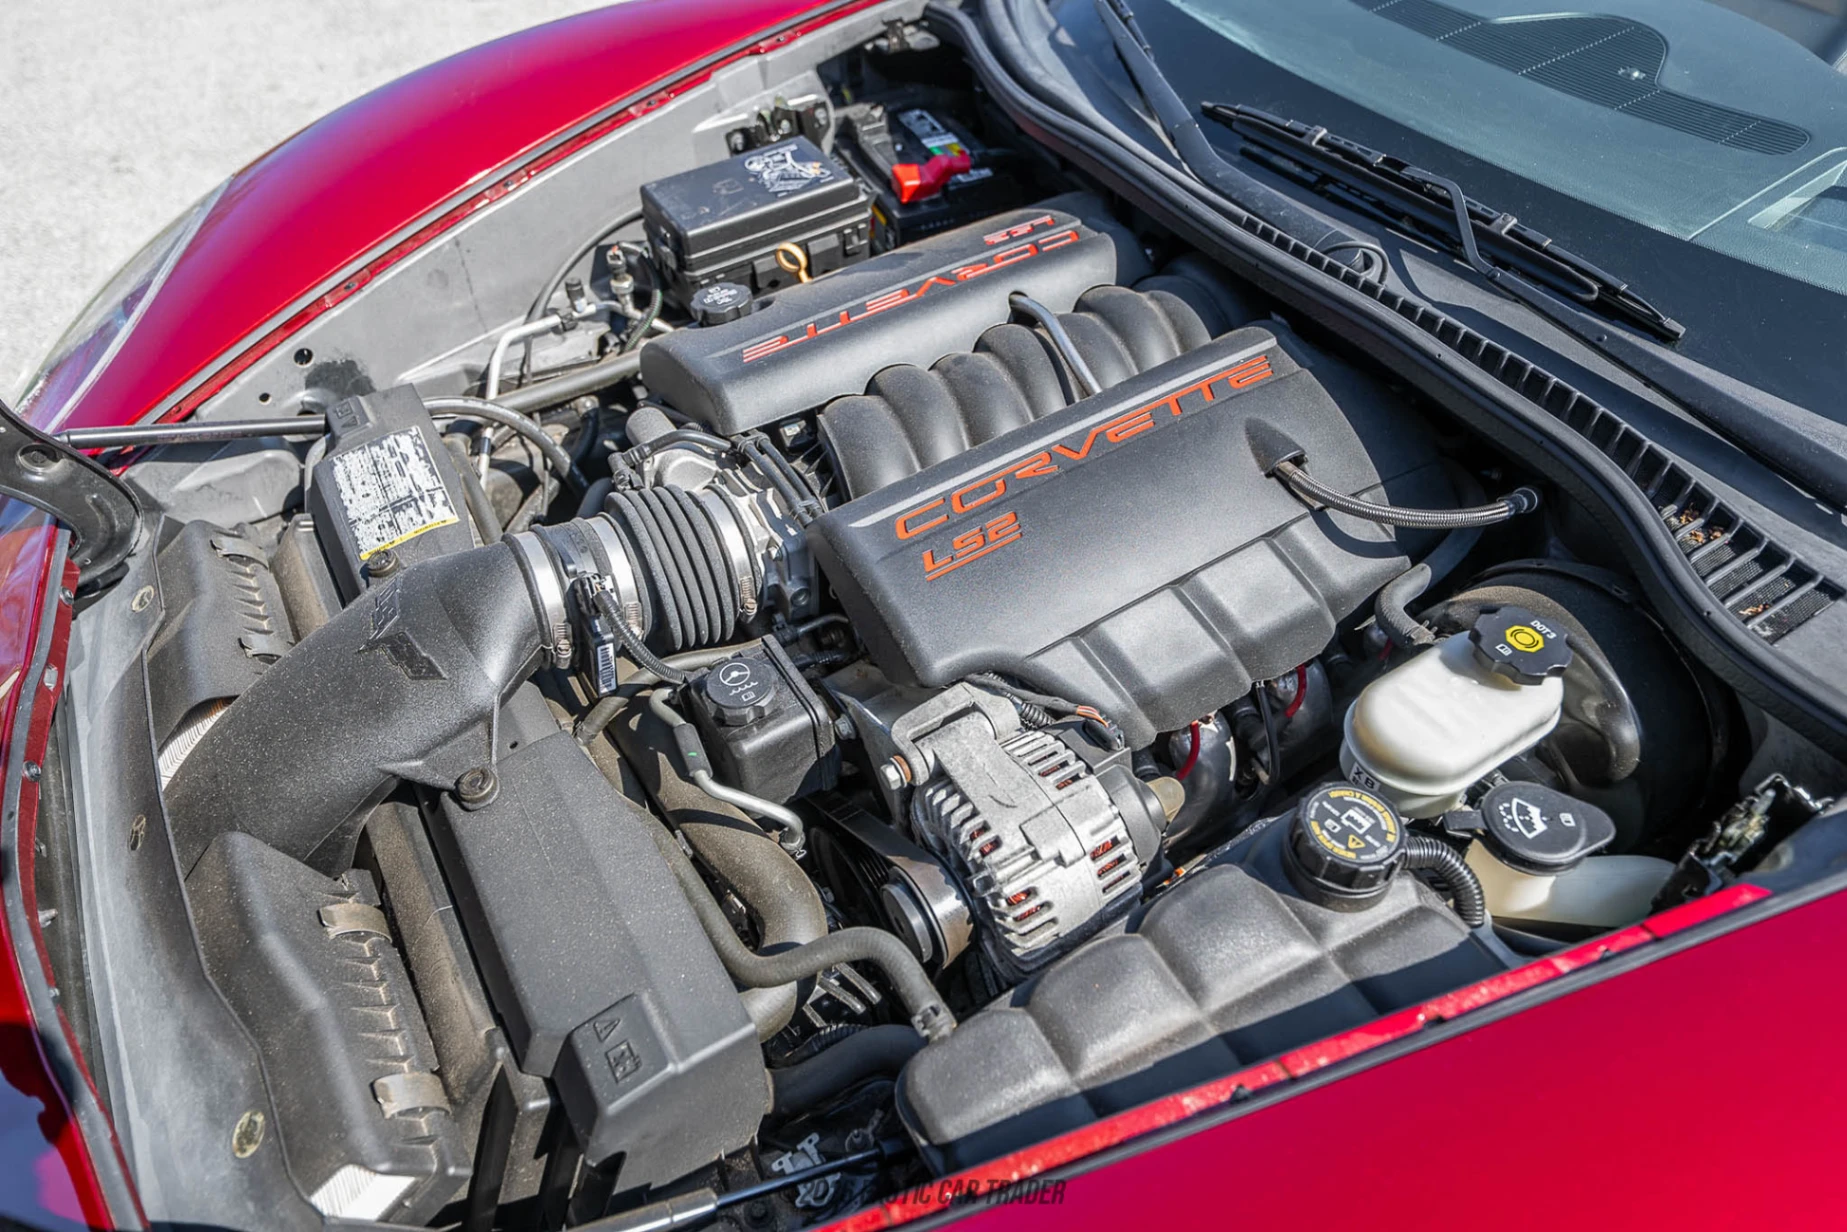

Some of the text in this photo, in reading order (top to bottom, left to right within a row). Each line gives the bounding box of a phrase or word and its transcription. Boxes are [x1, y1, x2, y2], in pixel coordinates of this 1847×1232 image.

[742, 230, 1080, 363] CORVETTE
[895, 355, 1274, 541] CORVETTE
[921, 510, 1023, 575] LS2
